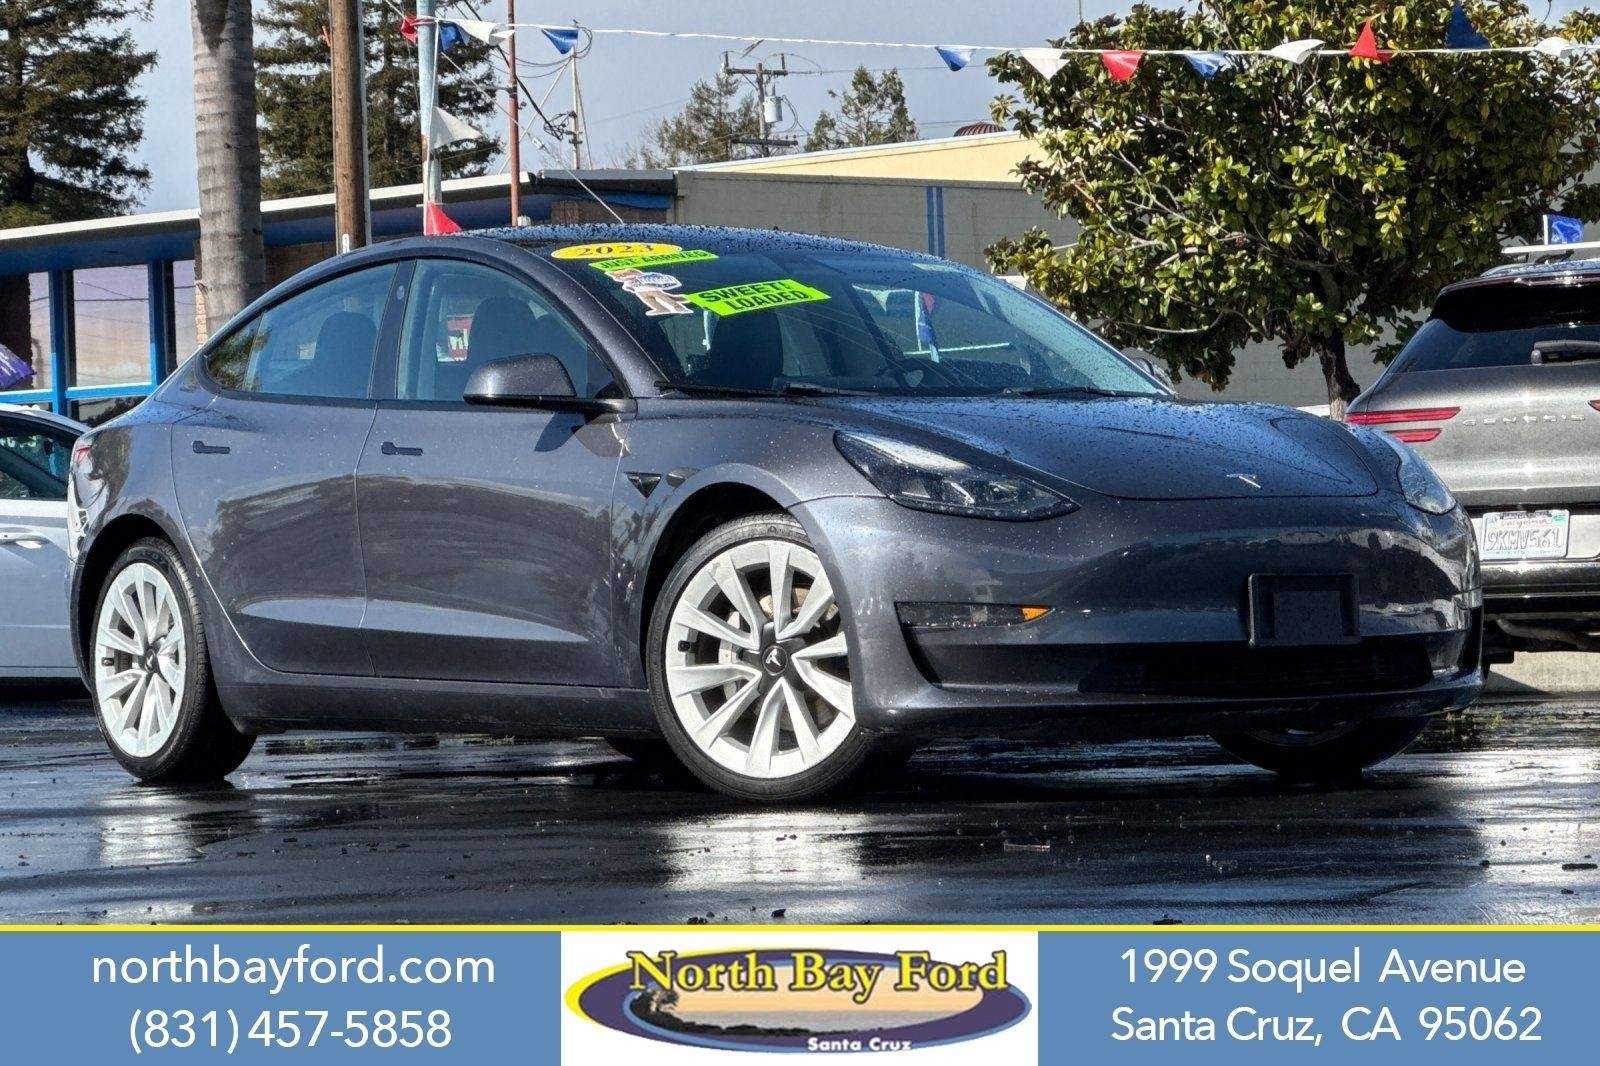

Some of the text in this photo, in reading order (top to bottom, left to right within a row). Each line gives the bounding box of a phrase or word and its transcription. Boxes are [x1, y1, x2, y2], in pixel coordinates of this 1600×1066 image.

[576, 244, 655, 257] 2023
[601, 250, 709, 269] JUST ARRIVED
[698, 281, 791, 302] SWEET!
[725, 290, 811, 310] LOADED
[1462, 413, 1586, 427] GENESIS
